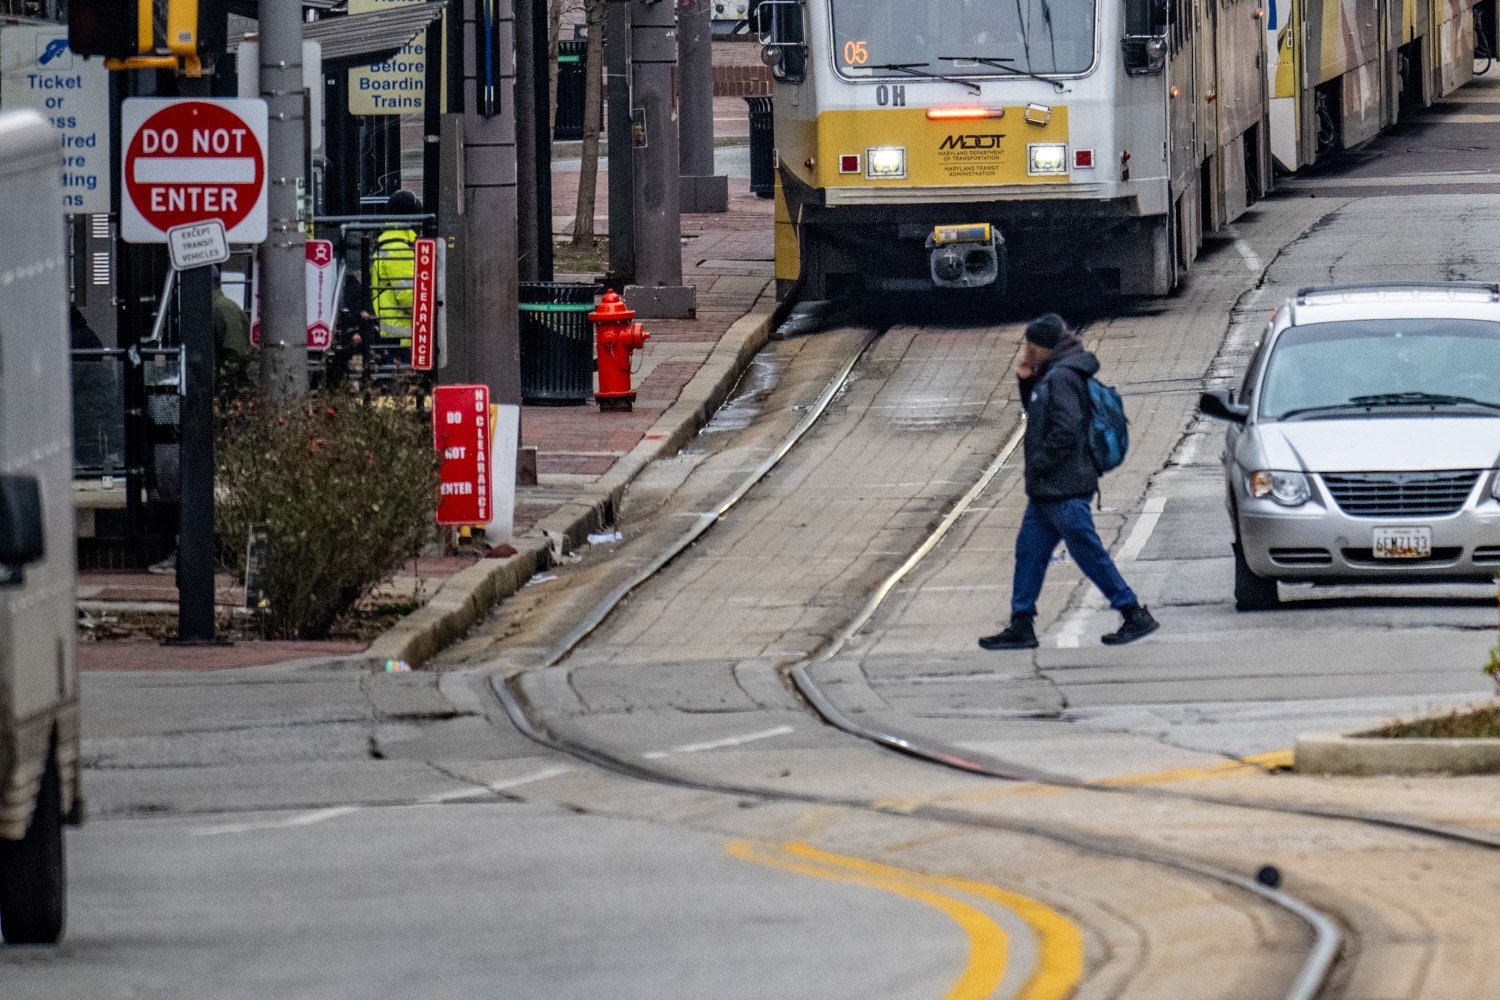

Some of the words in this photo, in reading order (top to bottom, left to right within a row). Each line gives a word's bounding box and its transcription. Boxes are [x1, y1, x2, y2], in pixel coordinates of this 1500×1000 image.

[844, 40, 868, 65] 05
[370, 62, 425, 73] Before
[27, 75, 82, 89] Ticket
[360, 77, 424, 91] Boardin
[371, 95, 422, 108] Trains
[876, 85, 906, 106] OH
[45, 98, 64, 109] or
[61, 133, 96, 148] ired
[142, 128, 179, 153] DO
[193, 128, 247, 153] NOT
[939, 134, 1006, 150] MDOT
[151, 187, 238, 212] ENTER
[182, 228, 210, 239] EXCEPT
[183, 239, 214, 250] TRANSIT
[182, 250, 219, 262] VEHICLES
[421, 245, 429, 265] NO
[418, 271, 429, 365] CLEARANCE
[475, 389, 484, 412] NO
[446, 411, 462, 424] DO
[444, 446, 466, 460] NOT
[475, 415, 486, 519] CLEARANCE
[440, 482, 472, 495] ENTER
